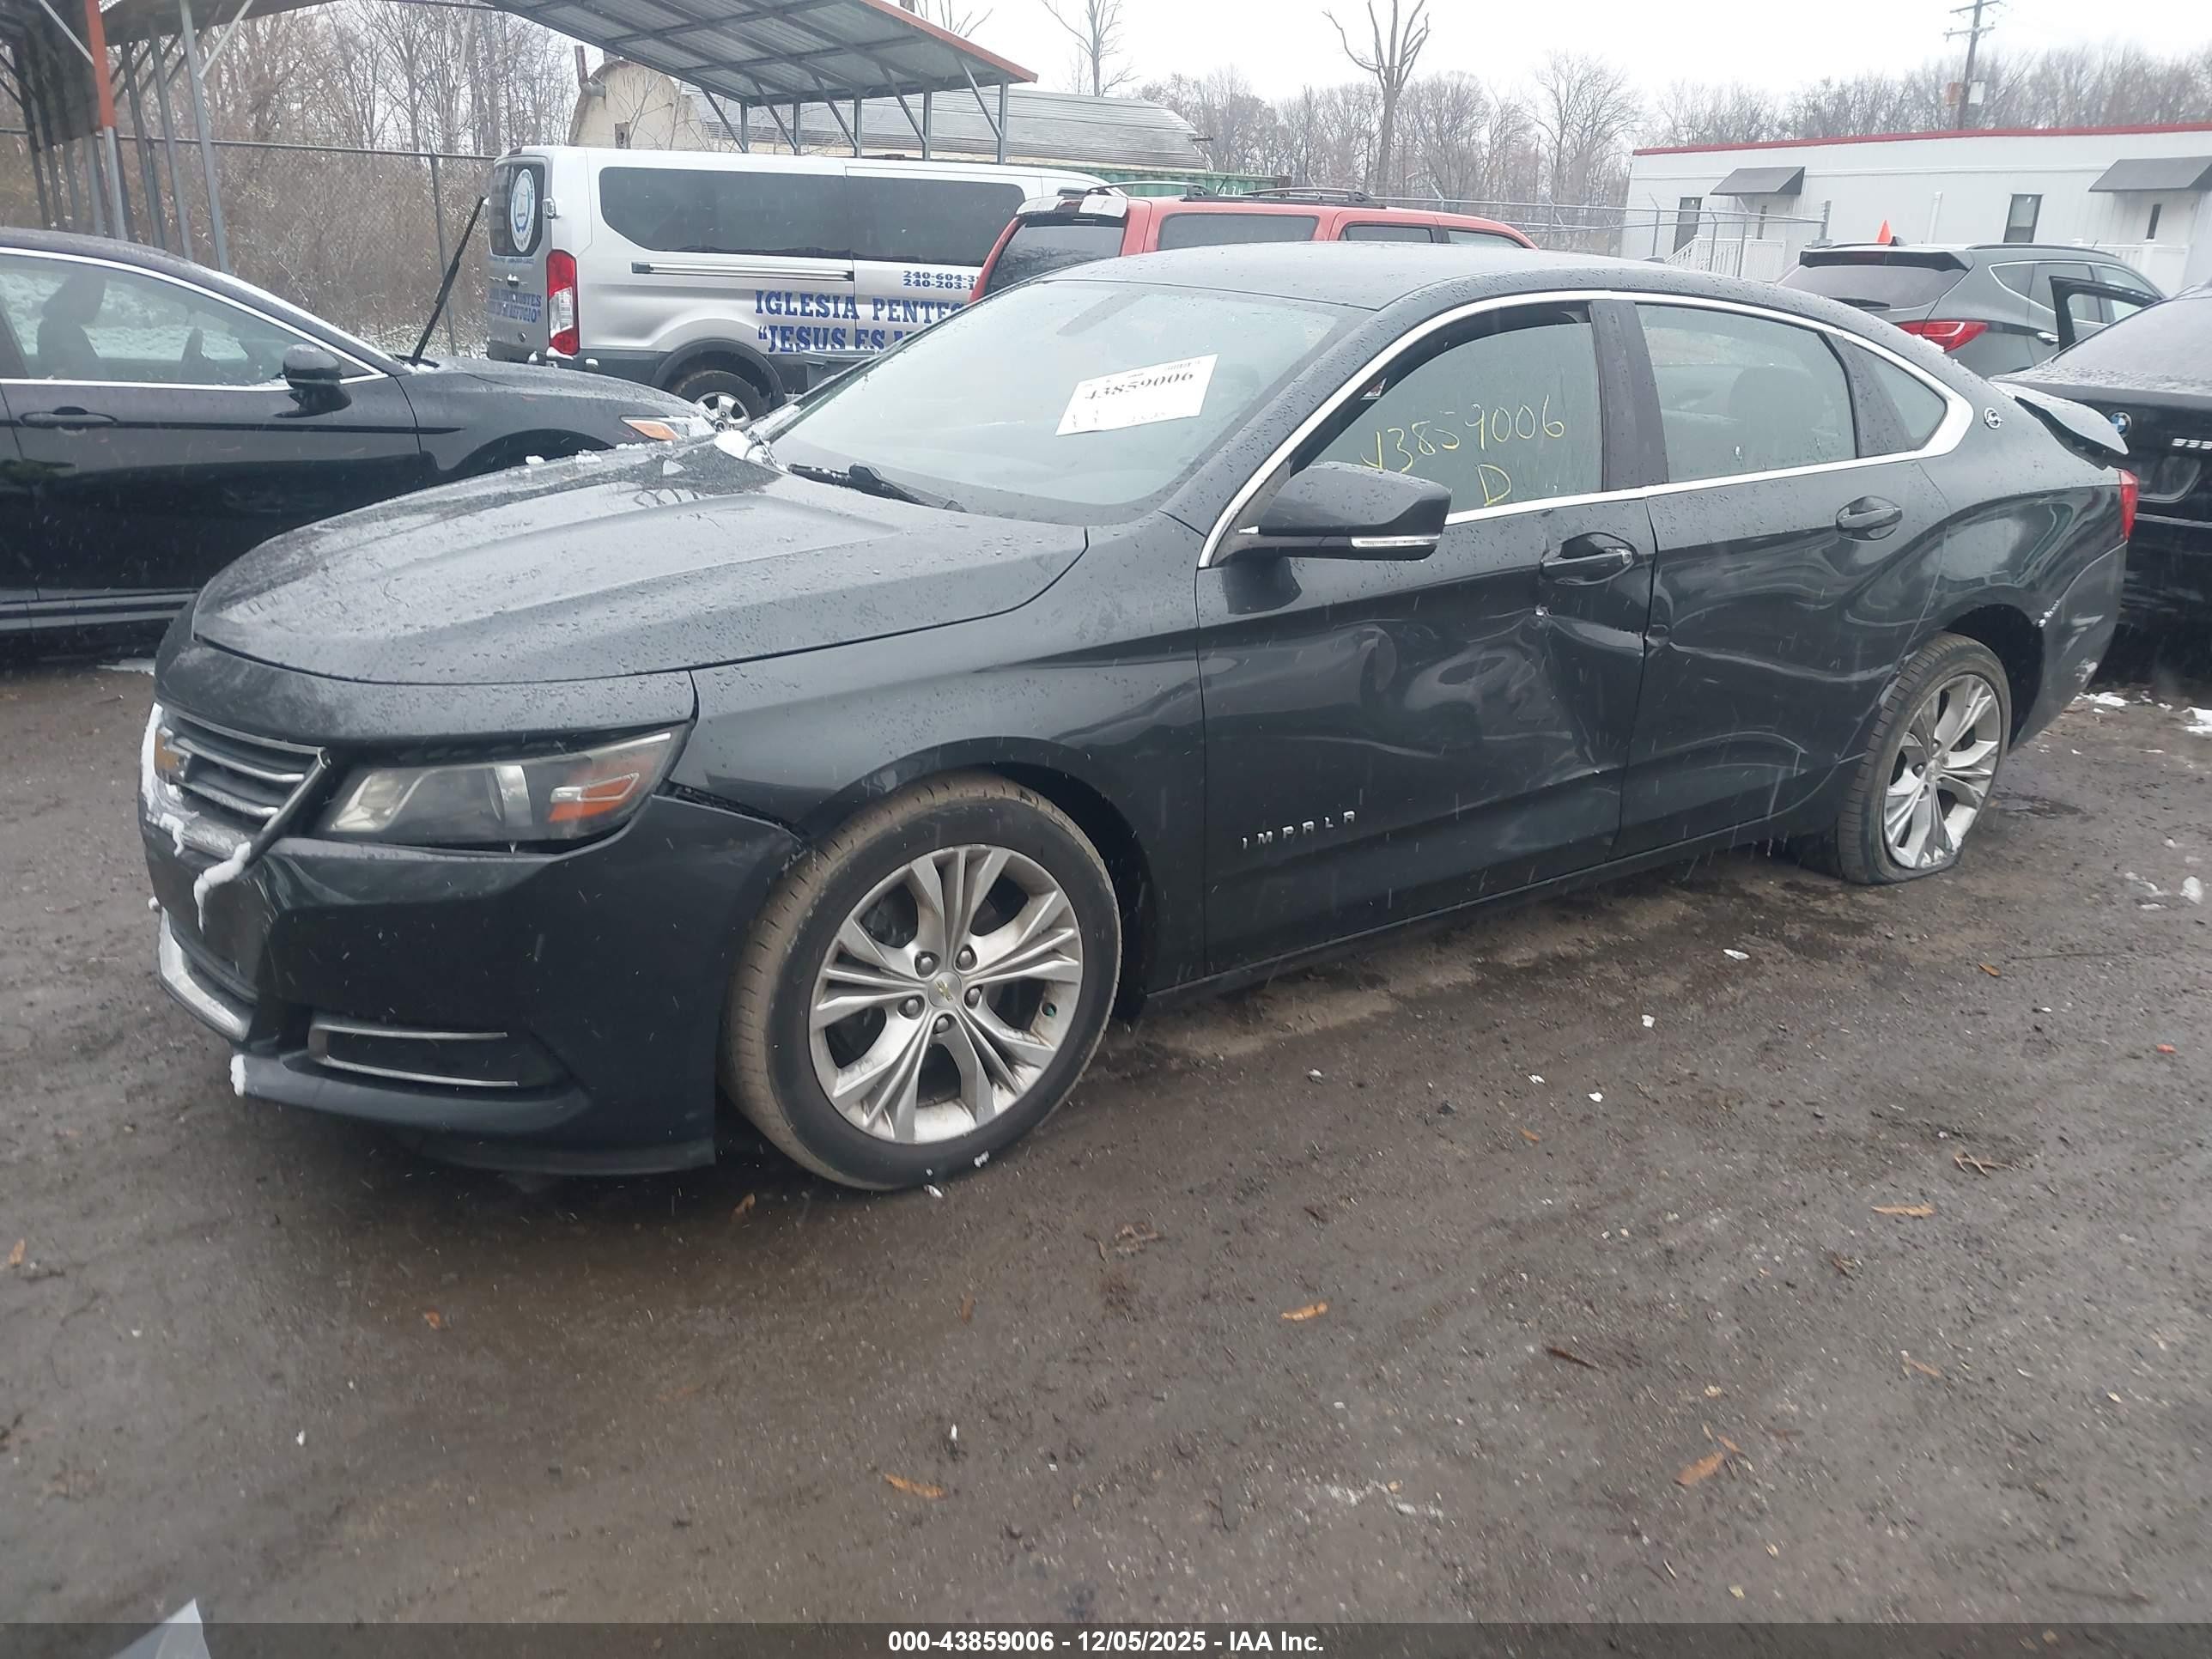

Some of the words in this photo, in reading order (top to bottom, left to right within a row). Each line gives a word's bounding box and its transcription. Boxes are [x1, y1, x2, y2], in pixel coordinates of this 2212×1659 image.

[903, 270, 979, 283] 240-604-3
[756, 290, 860, 319] IGLESIA
[1477, 464, 1511, 507] D
[1242, 810, 1356, 850] IMPALA
